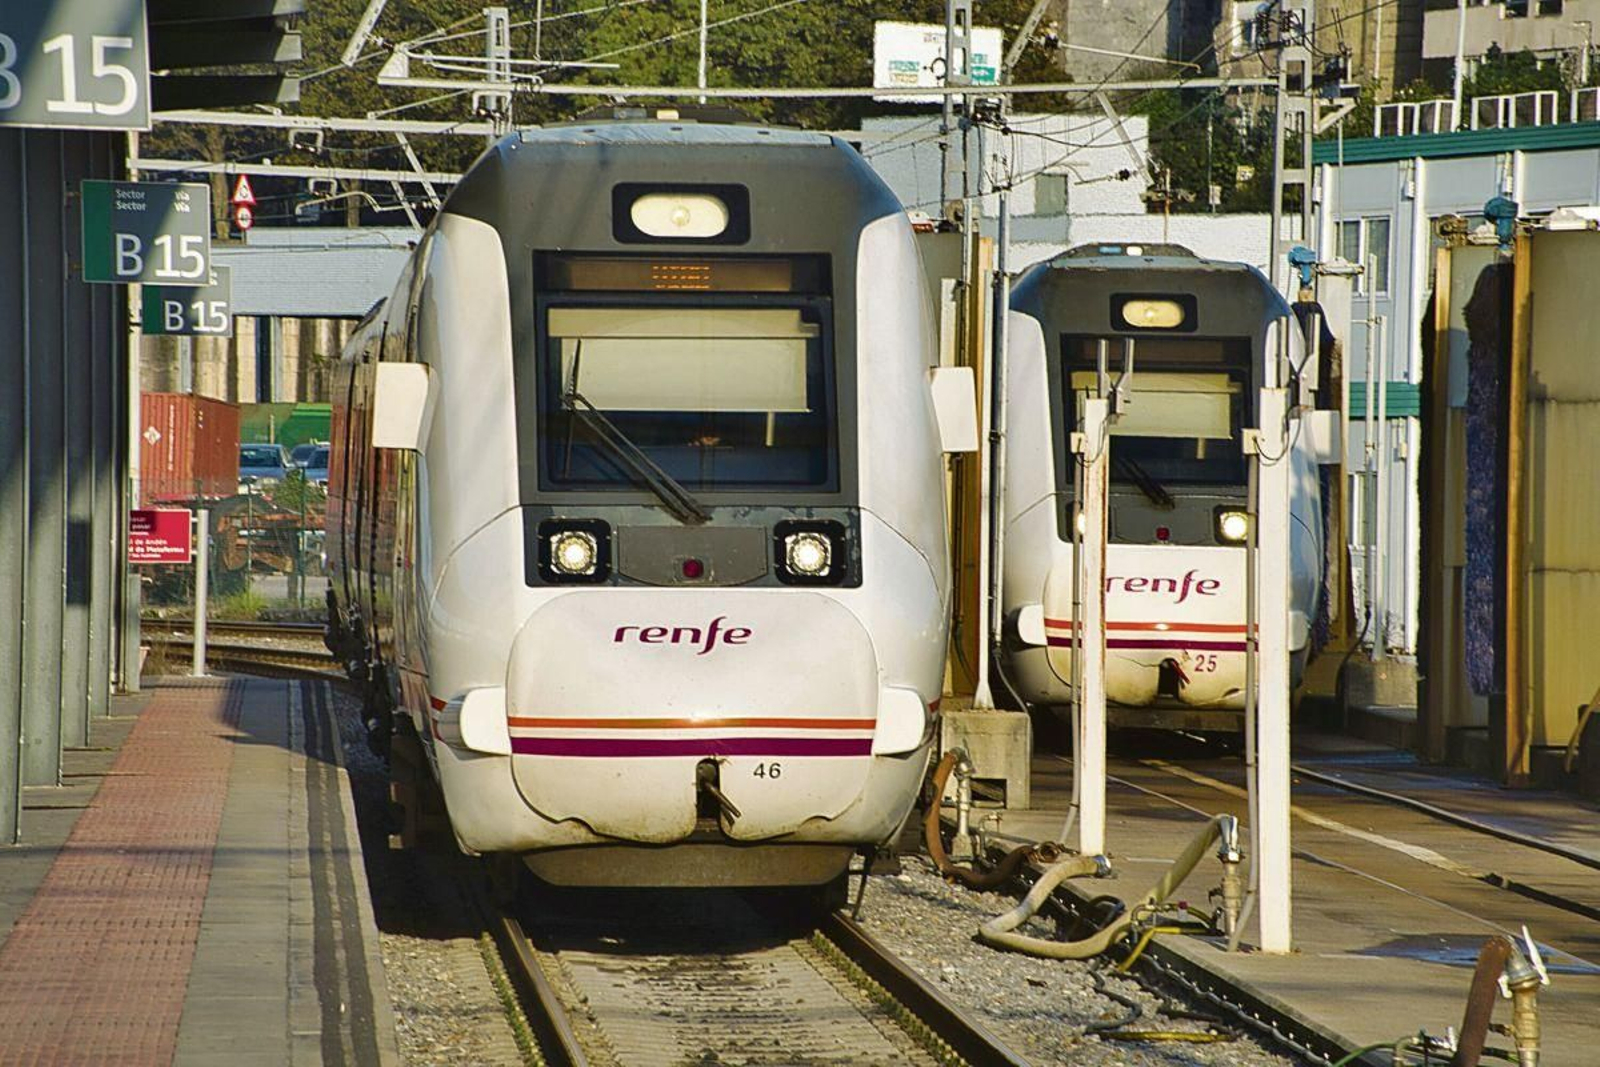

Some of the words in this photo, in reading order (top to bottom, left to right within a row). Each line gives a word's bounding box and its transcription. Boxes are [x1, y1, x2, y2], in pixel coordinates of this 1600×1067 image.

[43, 33, 138, 115] 15
[115, 189, 145, 200] Sector
[115, 200, 146, 211] Sector
[116, 233, 143, 276] B
[154, 234, 204, 278] 15
[165, 300, 183, 331] B
[191, 301, 228, 332] 15
[1106, 569, 1221, 604] renfe
[614, 616, 752, 655] renfe
[1194, 655, 1217, 672] 25
[753, 762, 781, 779] 46
